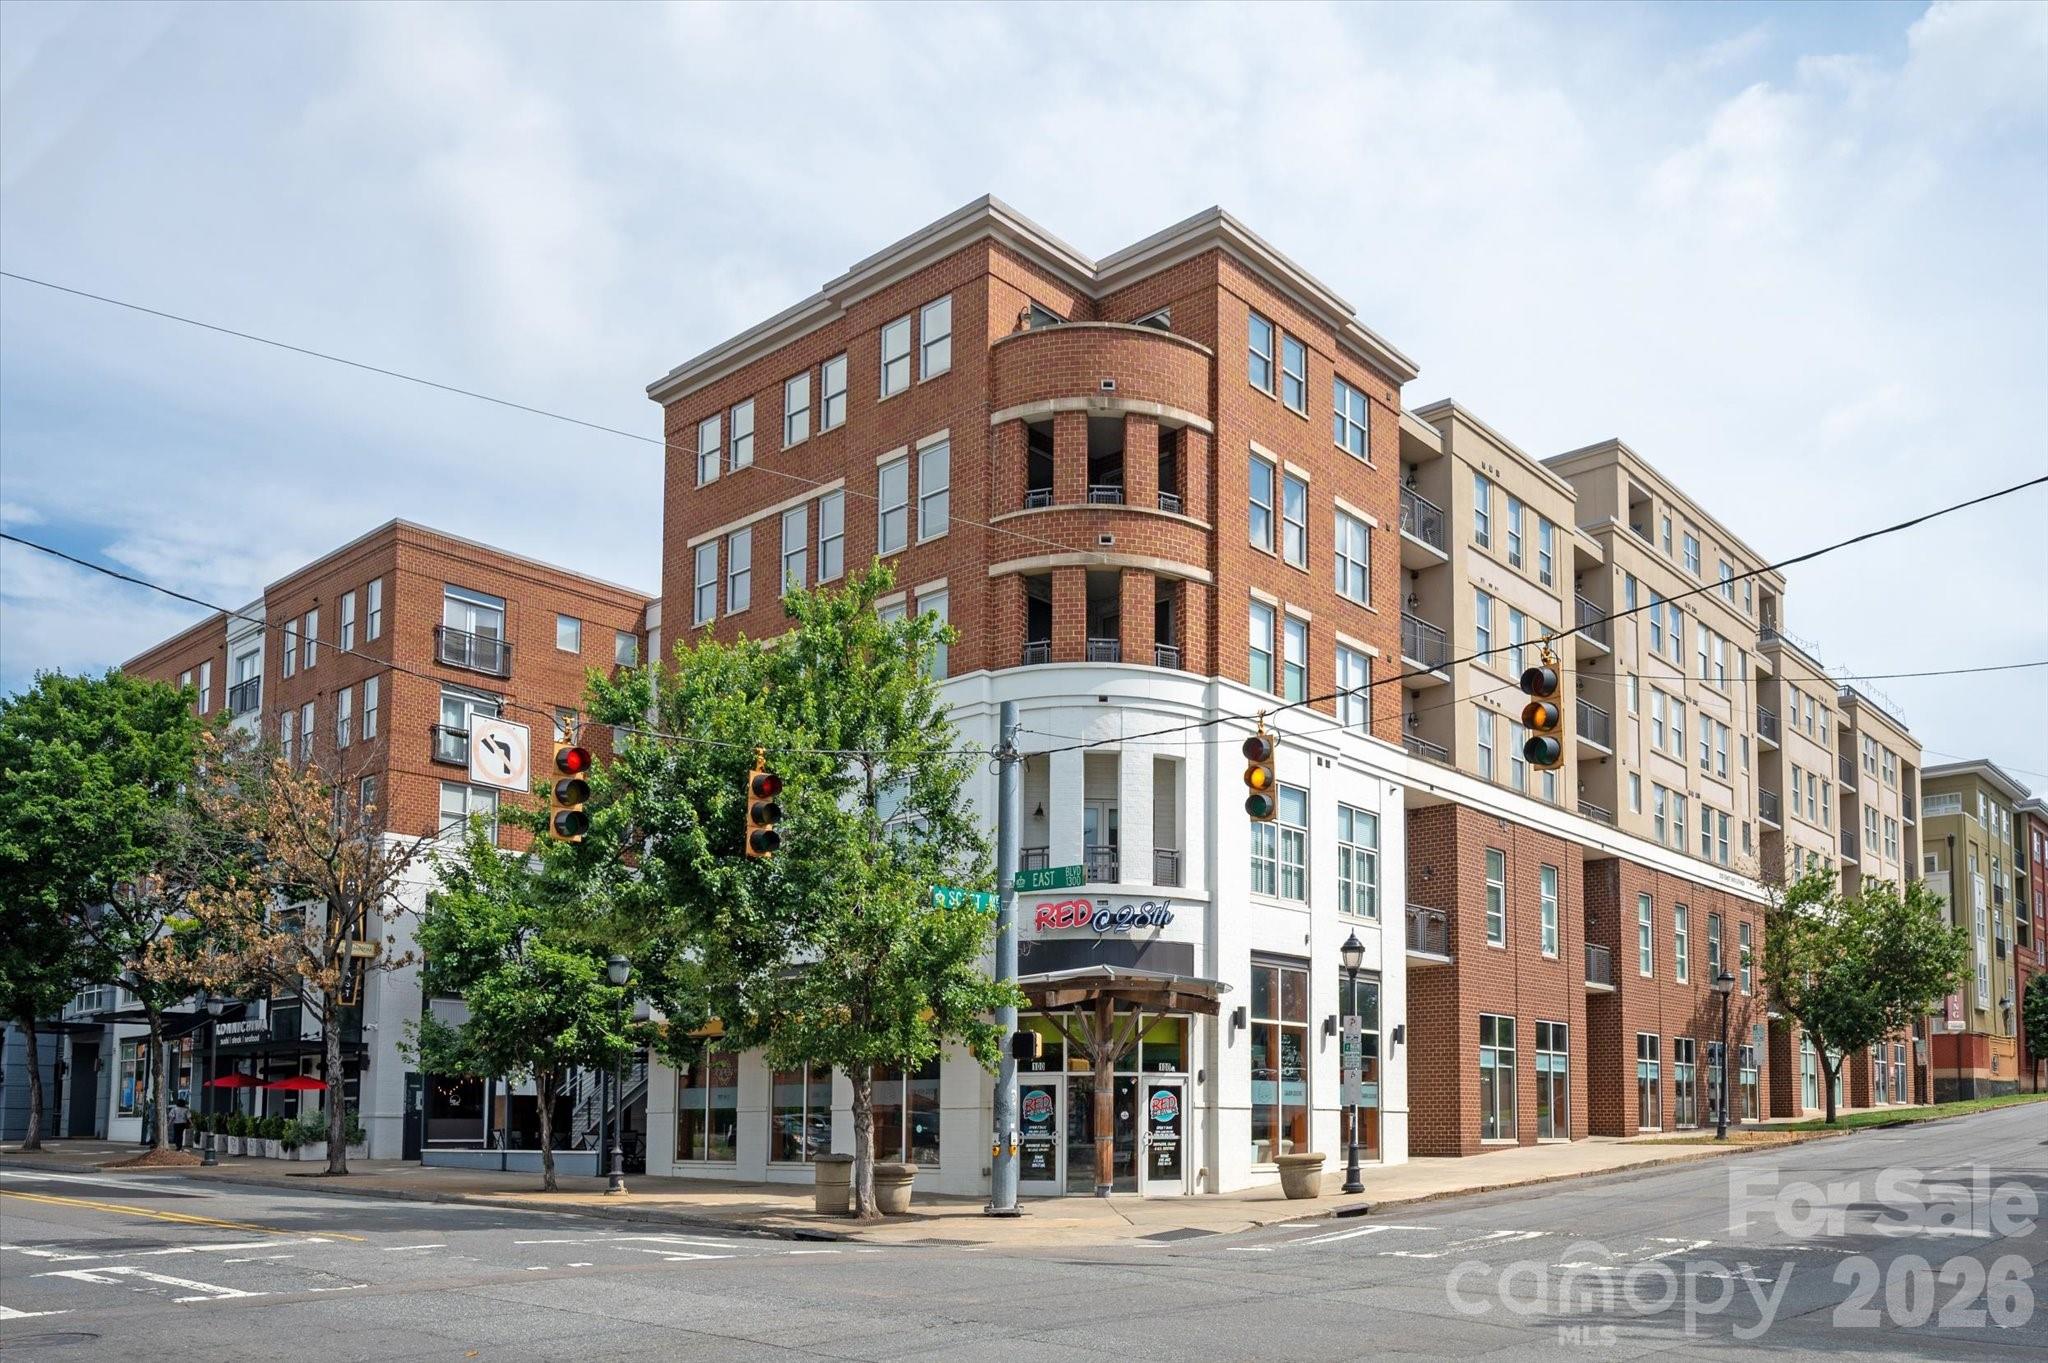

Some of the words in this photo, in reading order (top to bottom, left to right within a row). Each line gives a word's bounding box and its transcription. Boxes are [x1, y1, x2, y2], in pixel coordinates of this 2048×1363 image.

[1032, 870, 1055, 887] EAST
[1065, 866, 1082, 877] BLVD
[1065, 876, 1082, 886] 1300
[949, 891, 981, 909] SCT
[1035, 898, 1093, 933] RED
[216, 1020, 268, 1035] KONNICHIWA
